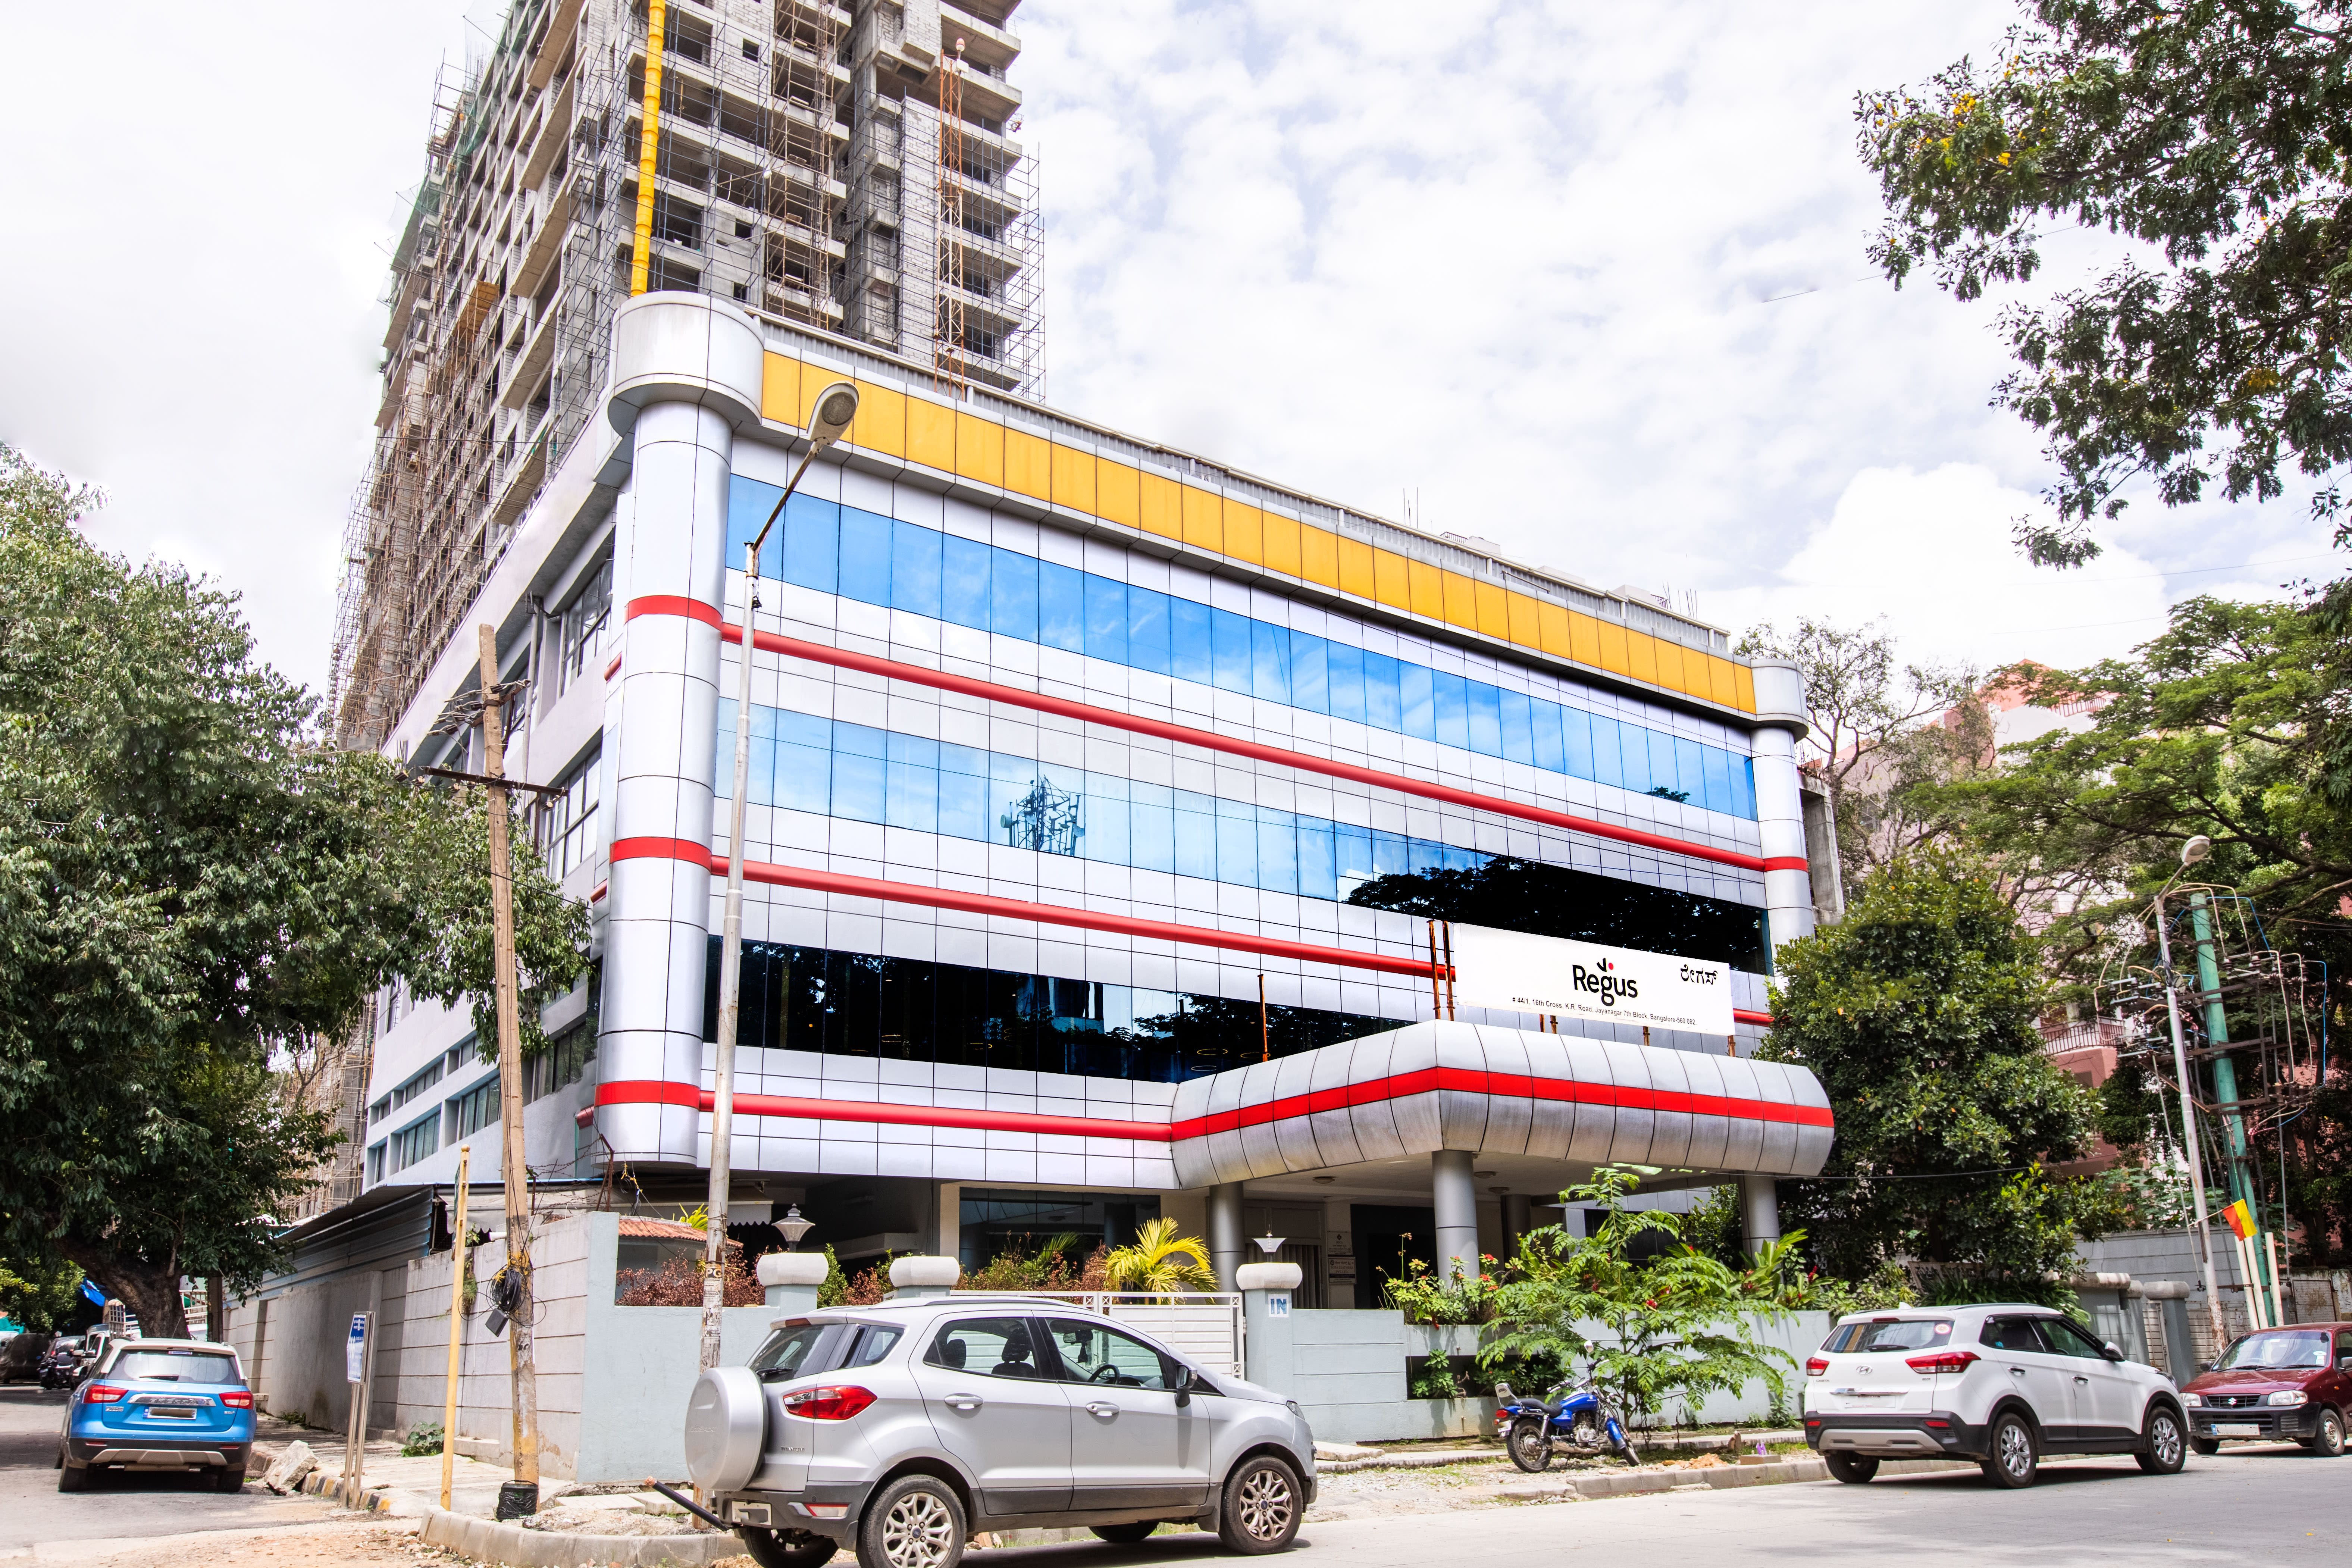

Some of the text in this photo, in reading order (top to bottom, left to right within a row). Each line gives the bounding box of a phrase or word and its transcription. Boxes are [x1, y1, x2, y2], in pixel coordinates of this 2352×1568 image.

[1572, 964, 1638, 1007] Regus
[1546, 1001, 1564, 1009] Cross,
[1595, 1007, 1622, 1017] Jayanagar
[1650, 1014, 1685, 1024] Bangalore-560
[705, 1268, 721, 1277] PG
[1271, 1298, 1287, 1314] IN
